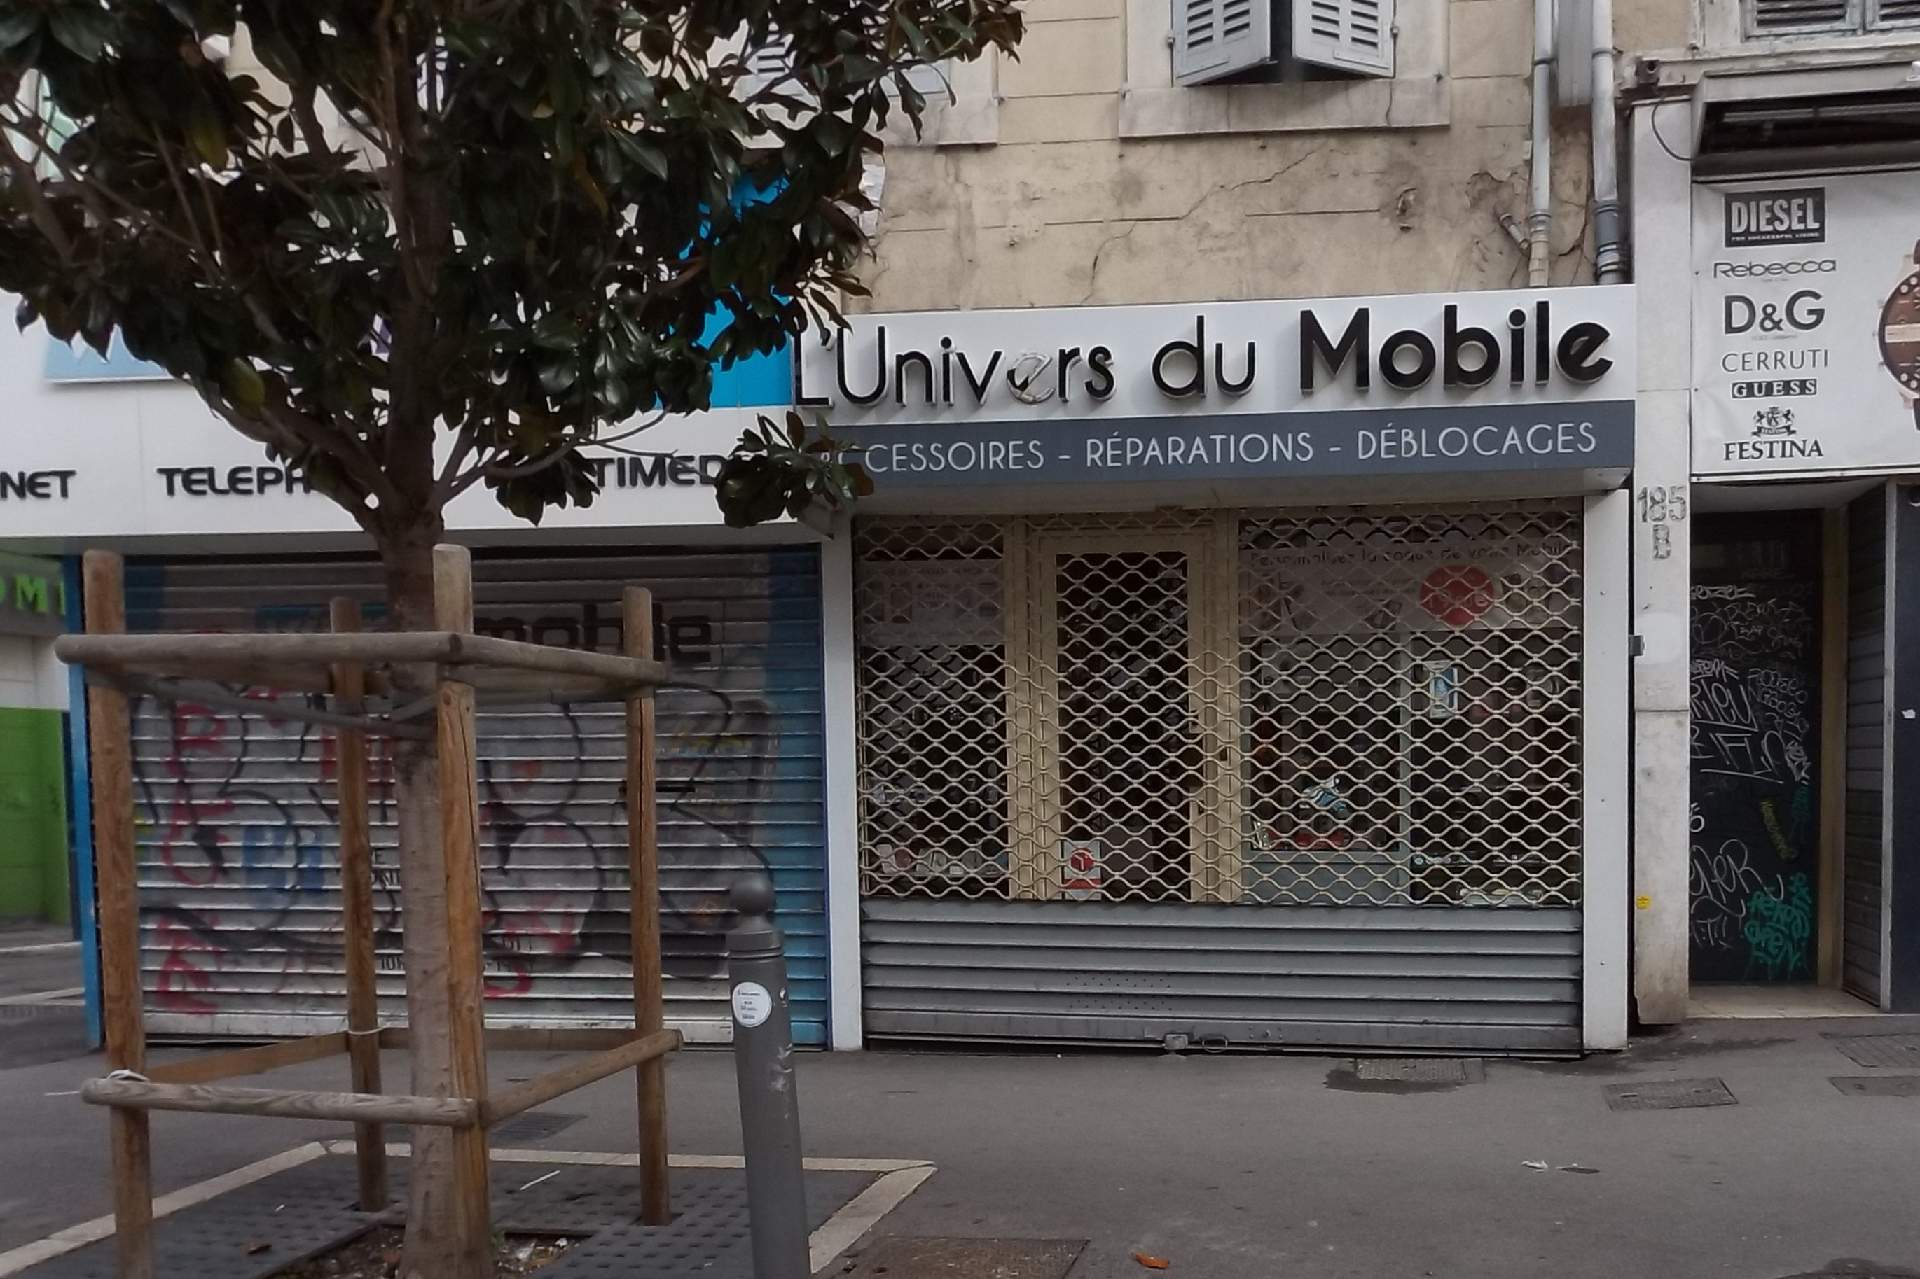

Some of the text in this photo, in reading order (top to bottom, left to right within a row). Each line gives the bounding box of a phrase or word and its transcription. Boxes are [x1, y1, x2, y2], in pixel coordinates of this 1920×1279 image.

[1731, 198, 1820, 233] DIESEL
[1713, 259, 1837, 279] Rebecca
[1724, 290, 1826, 335] D&G
[794, 301, 1613, 406] L'Univers du Mobile
[1721, 349, 1829, 373] CERRUTI
[1733, 379, 1816, 398] GUESS
[820, 439, 1044, 473] CESSOIRES
[1086, 431, 1314, 468] RÉPARATIONS
[1357, 422, 1597, 460] DÉBLOCAGES
[1723, 440, 1824, 461] FESTINA
[1638, 486, 1687, 523] 185
[473, 603, 712, 665] moble
